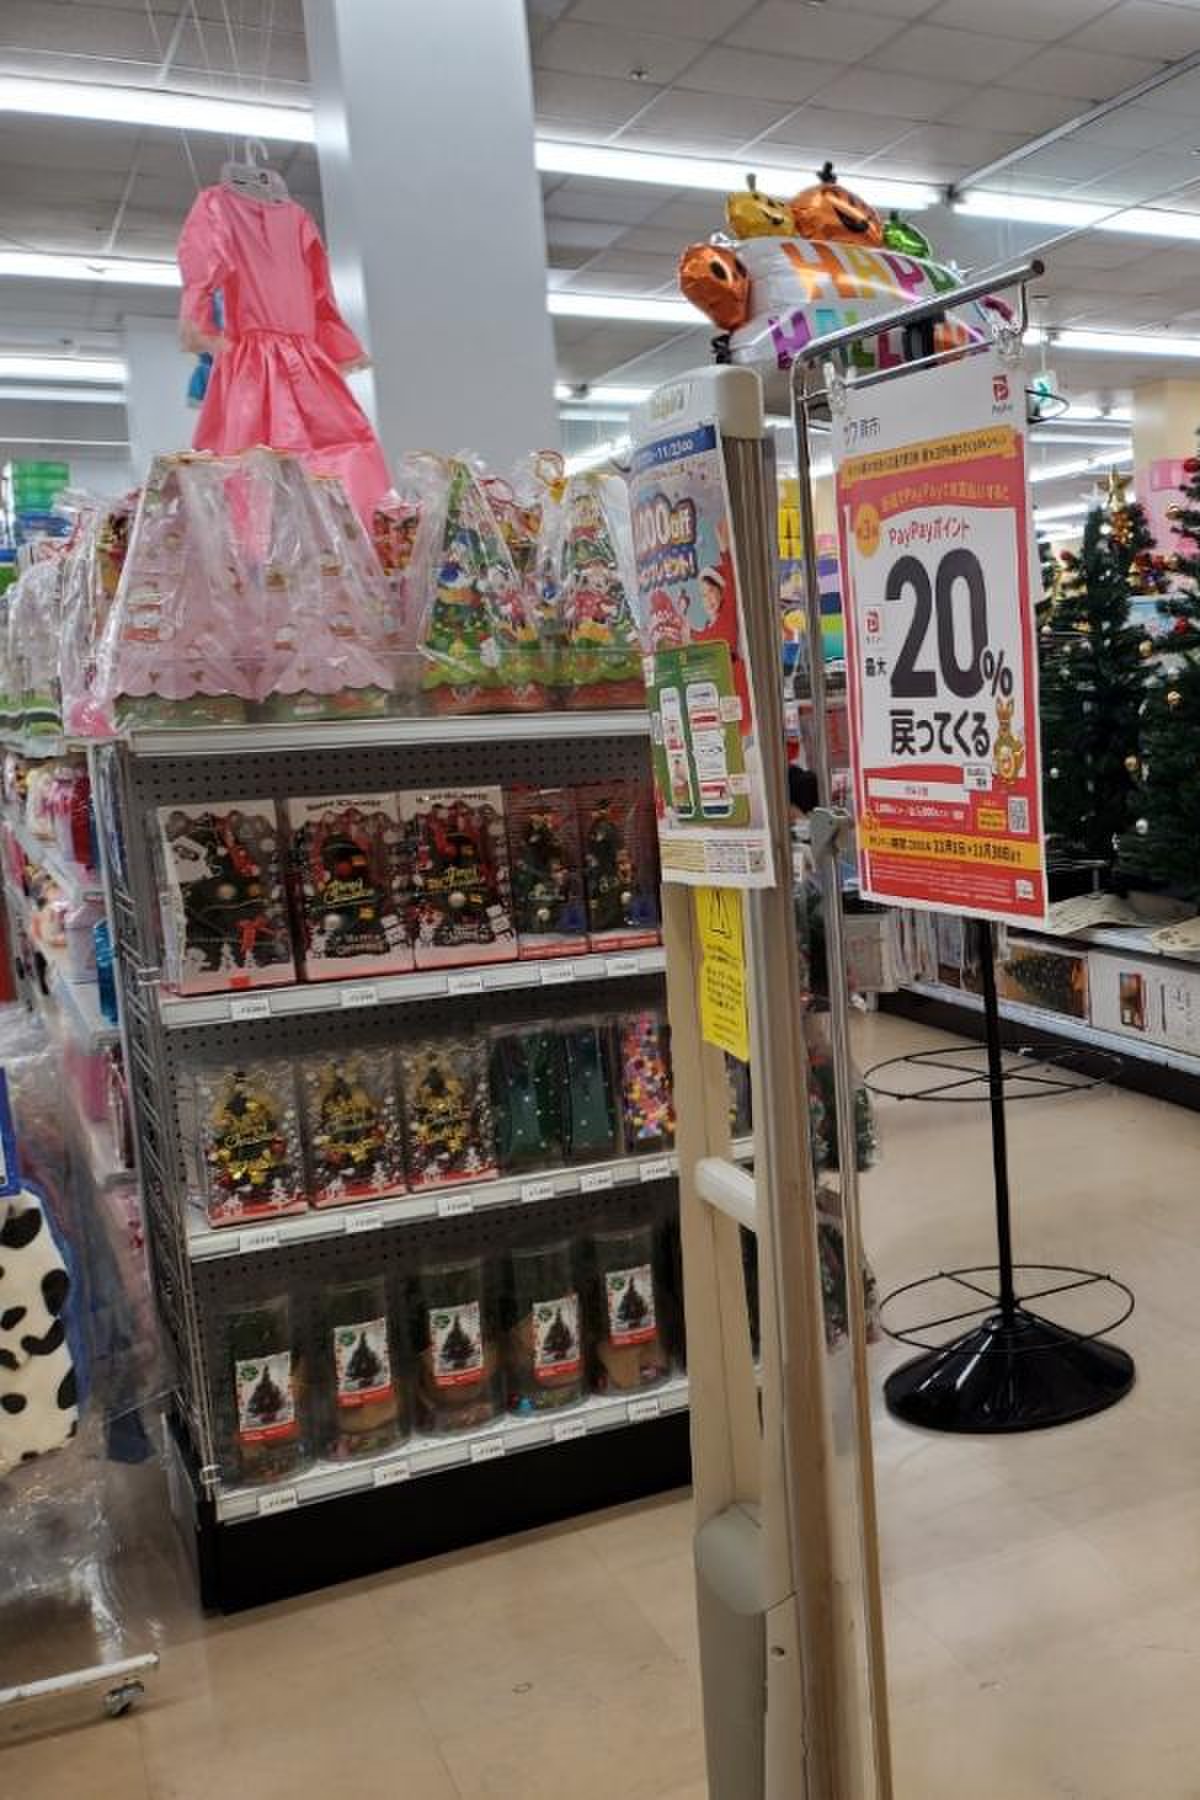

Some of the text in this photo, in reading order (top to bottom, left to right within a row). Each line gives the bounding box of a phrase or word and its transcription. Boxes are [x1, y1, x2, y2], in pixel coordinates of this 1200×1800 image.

[889, 517, 970, 549] PayPayポイント
[886, 548, 1013, 698] 20%
[889, 709, 990, 757] 戻ってくる
